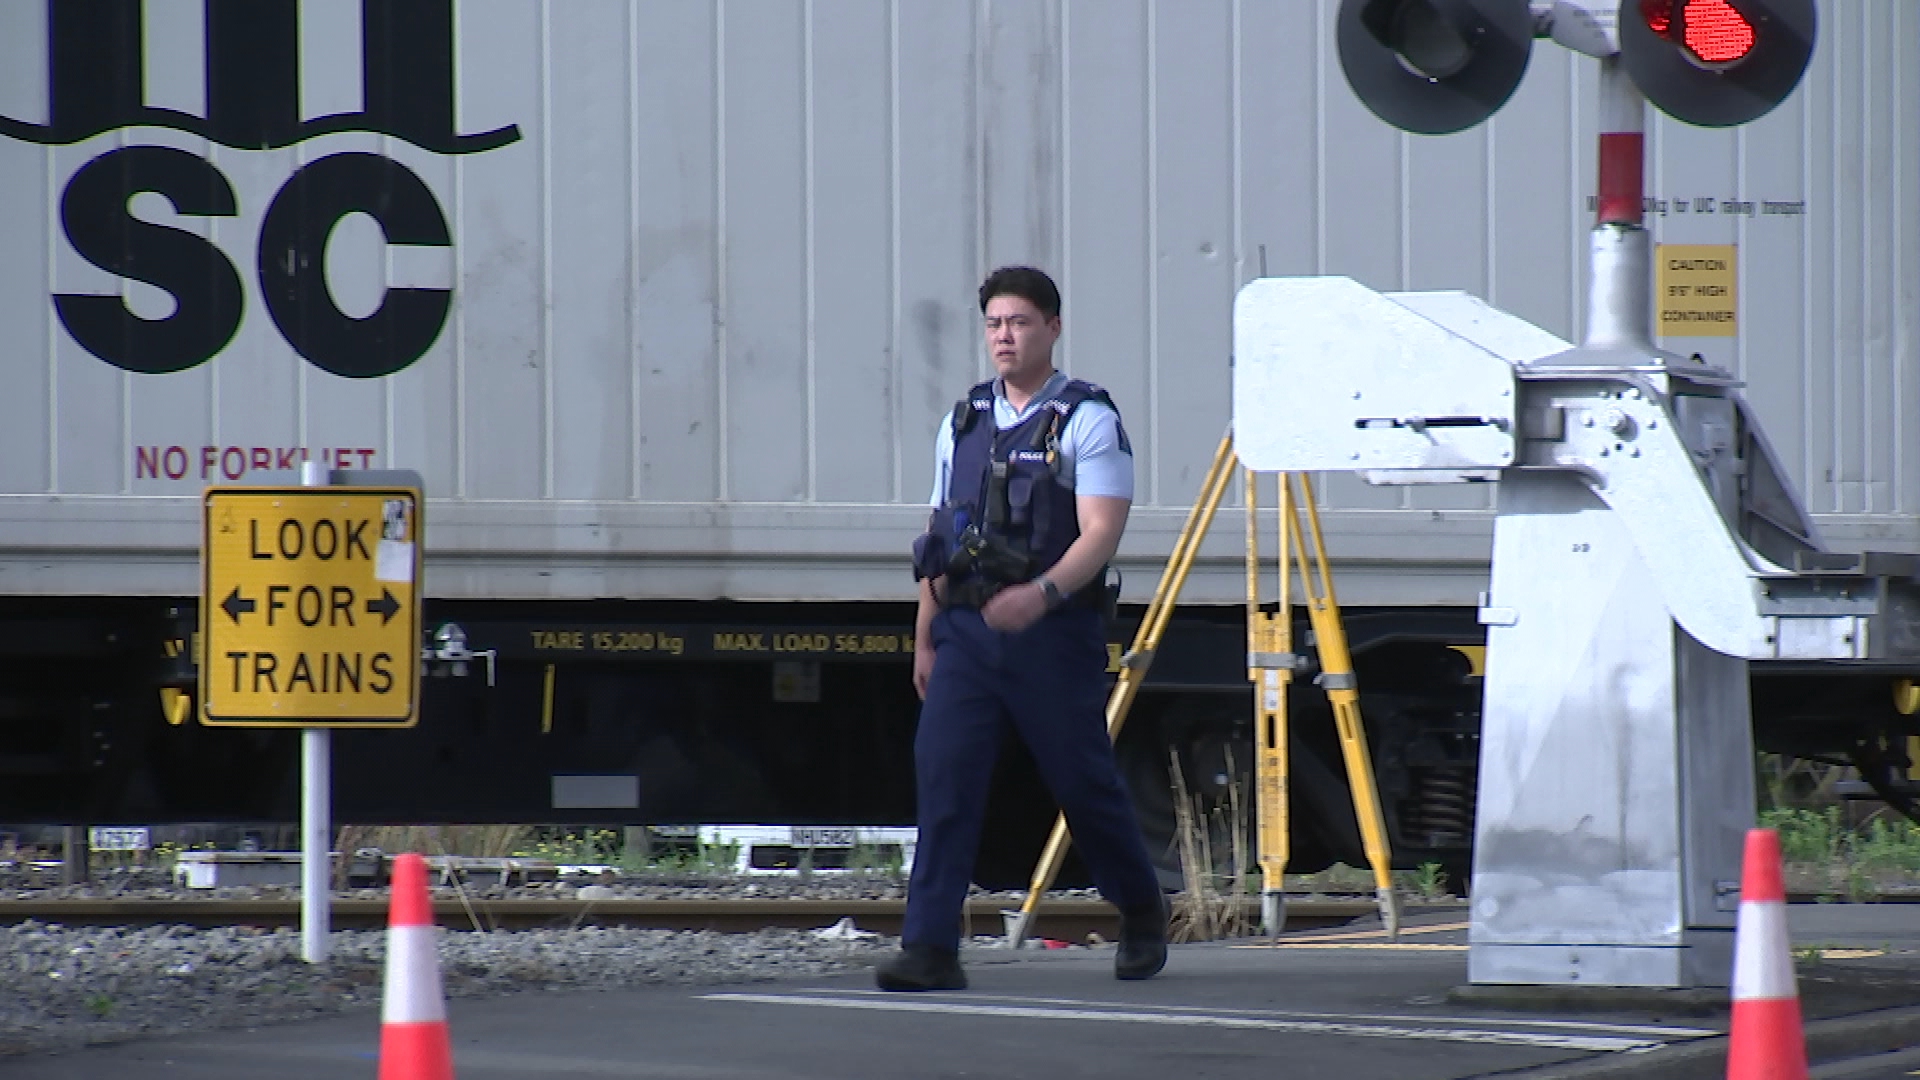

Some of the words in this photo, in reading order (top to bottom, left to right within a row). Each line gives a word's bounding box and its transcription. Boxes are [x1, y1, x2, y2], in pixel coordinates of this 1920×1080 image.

[1668, 259, 1727, 271] CAUTION
[1694, 285, 1728, 297] HIGH
[1662, 310, 1736, 323] CONTAINER
[136, 446, 189, 480] NO
[250, 519, 370, 561] LOOK
[266, 585, 355, 627] FOR
[531, 631, 584, 649] TARE
[591, 631, 654, 652] 15,200
[657, 631, 685, 655] kg
[713, 633, 769, 651] MAX.
[773, 634, 831, 652] LOAD
[226, 652, 395, 694] TRAINS
